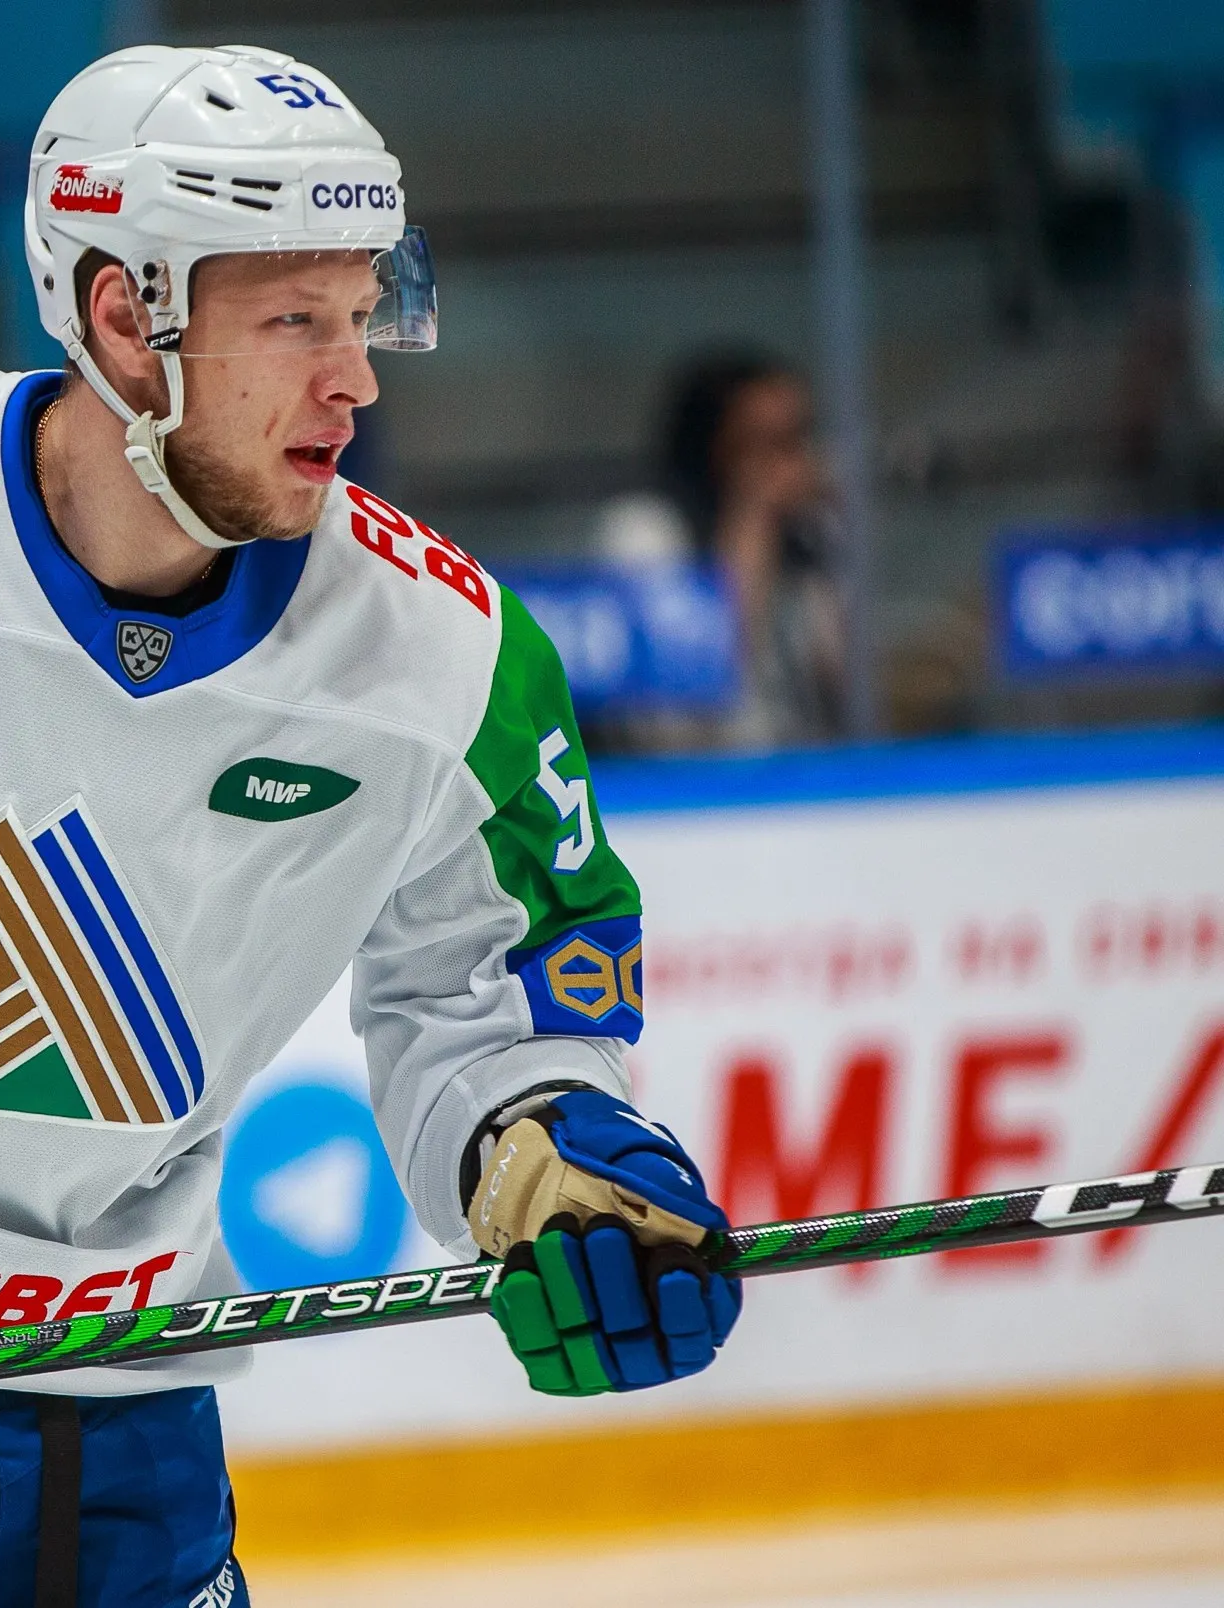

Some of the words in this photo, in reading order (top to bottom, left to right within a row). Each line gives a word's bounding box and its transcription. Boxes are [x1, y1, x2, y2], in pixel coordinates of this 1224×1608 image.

[255, 74, 345, 109] 52
[52, 171, 115, 199] FONBET
[149, 331, 180, 347] CCM
[245, 775, 311, 804] МИР
